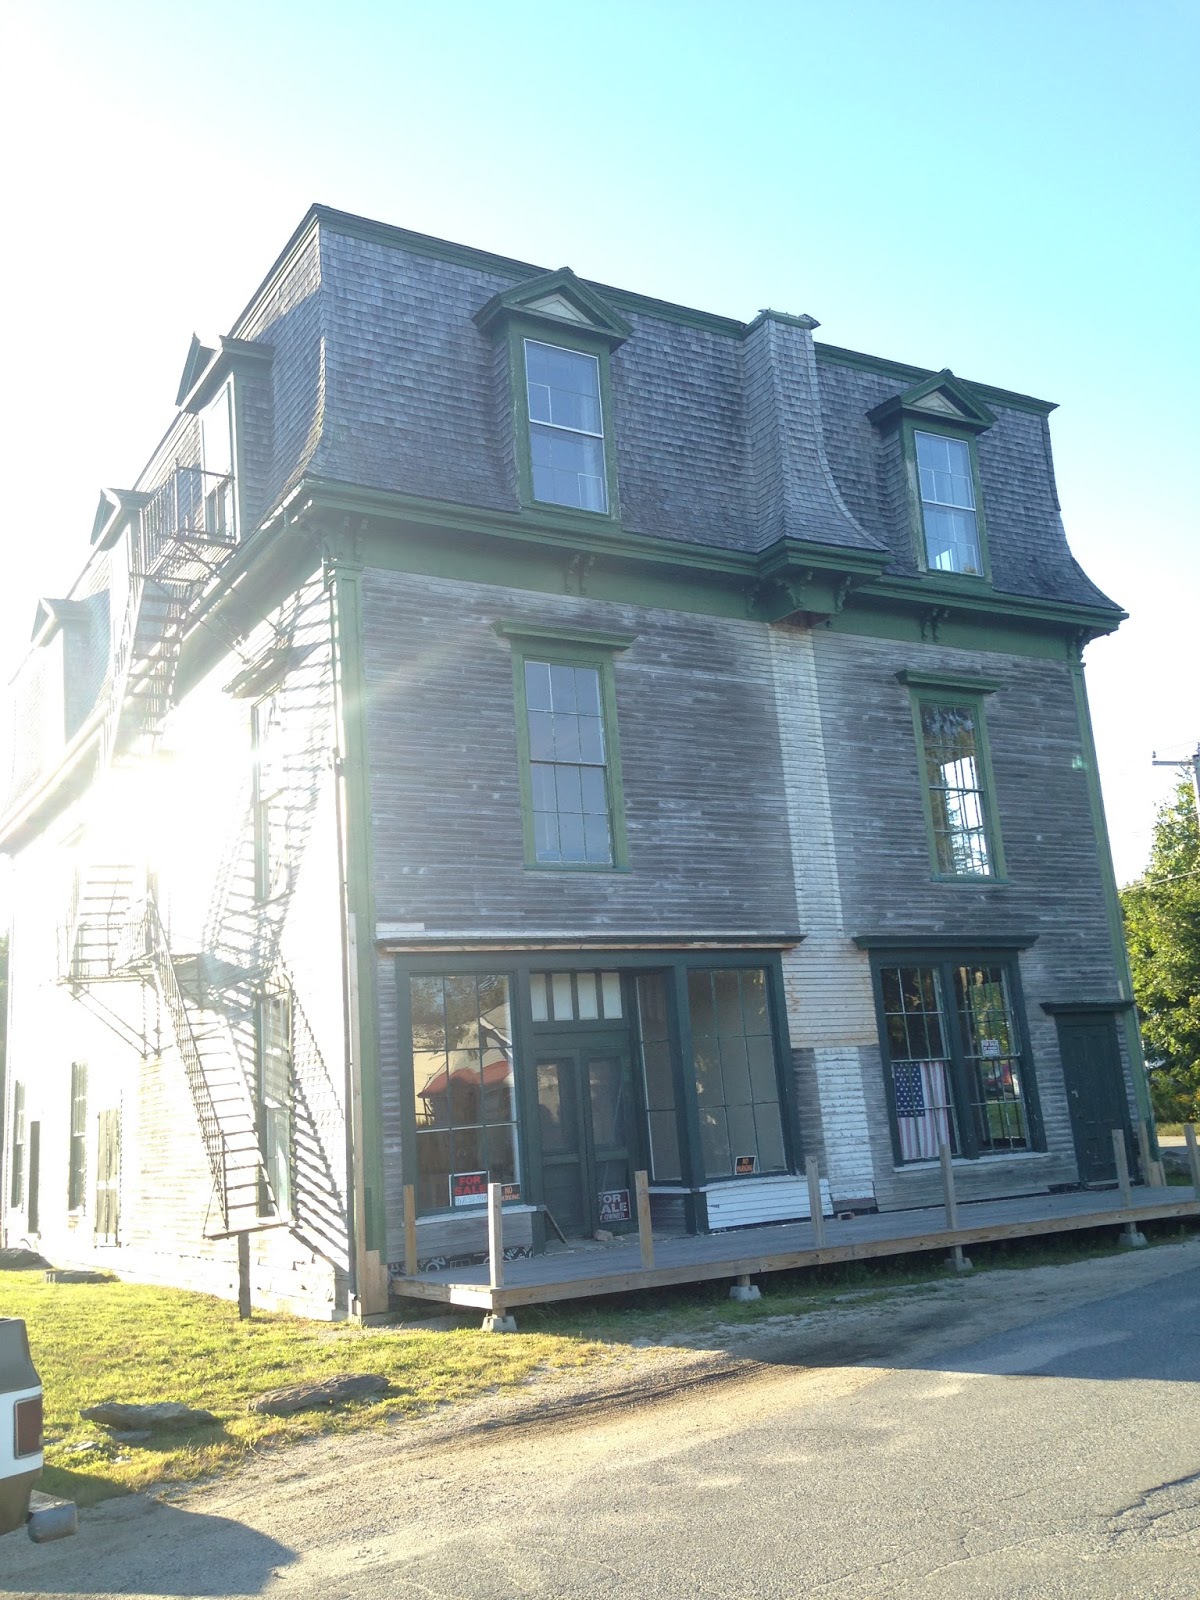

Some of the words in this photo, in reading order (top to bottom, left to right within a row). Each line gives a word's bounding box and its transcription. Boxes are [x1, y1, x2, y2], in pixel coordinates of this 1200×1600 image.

[458, 1176, 480, 1185] FOR
[455, 1185, 486, 1195] SALE
[504, 1186, 513, 1194] NO
[601, 1202, 627, 1214] ALE
